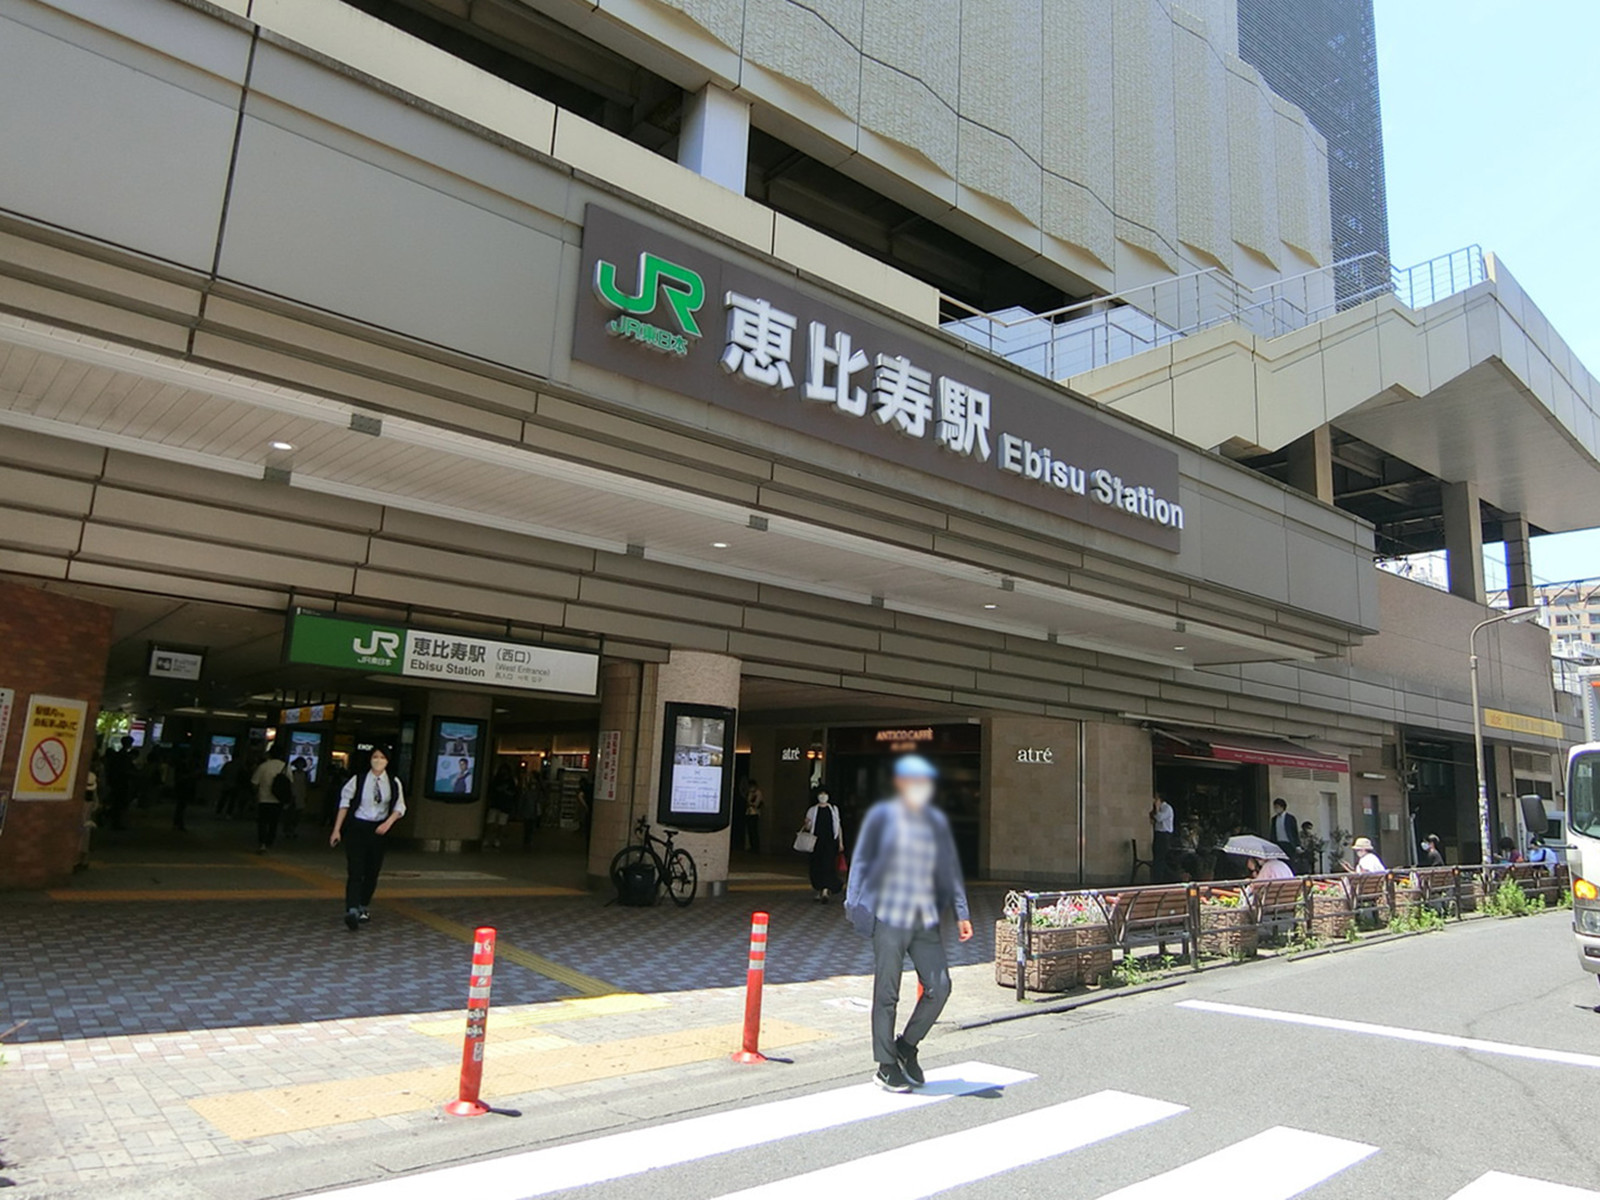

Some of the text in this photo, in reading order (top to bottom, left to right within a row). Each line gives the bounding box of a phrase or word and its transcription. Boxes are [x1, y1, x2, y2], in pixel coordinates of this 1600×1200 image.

[594, 252, 704, 337] JR
[607, 315, 688, 355] JR東日本
[721, 290, 991, 463] 恵比寿駅
[999, 432, 1183, 529] Ebisu Station
[354, 631, 400, 658] JR
[412, 637, 487, 663] 恵比寿駅
[357, 657, 391, 666] JR東日本
[410, 659, 486, 677] Ebisu Station
[1017, 746, 1054, 763] atré
